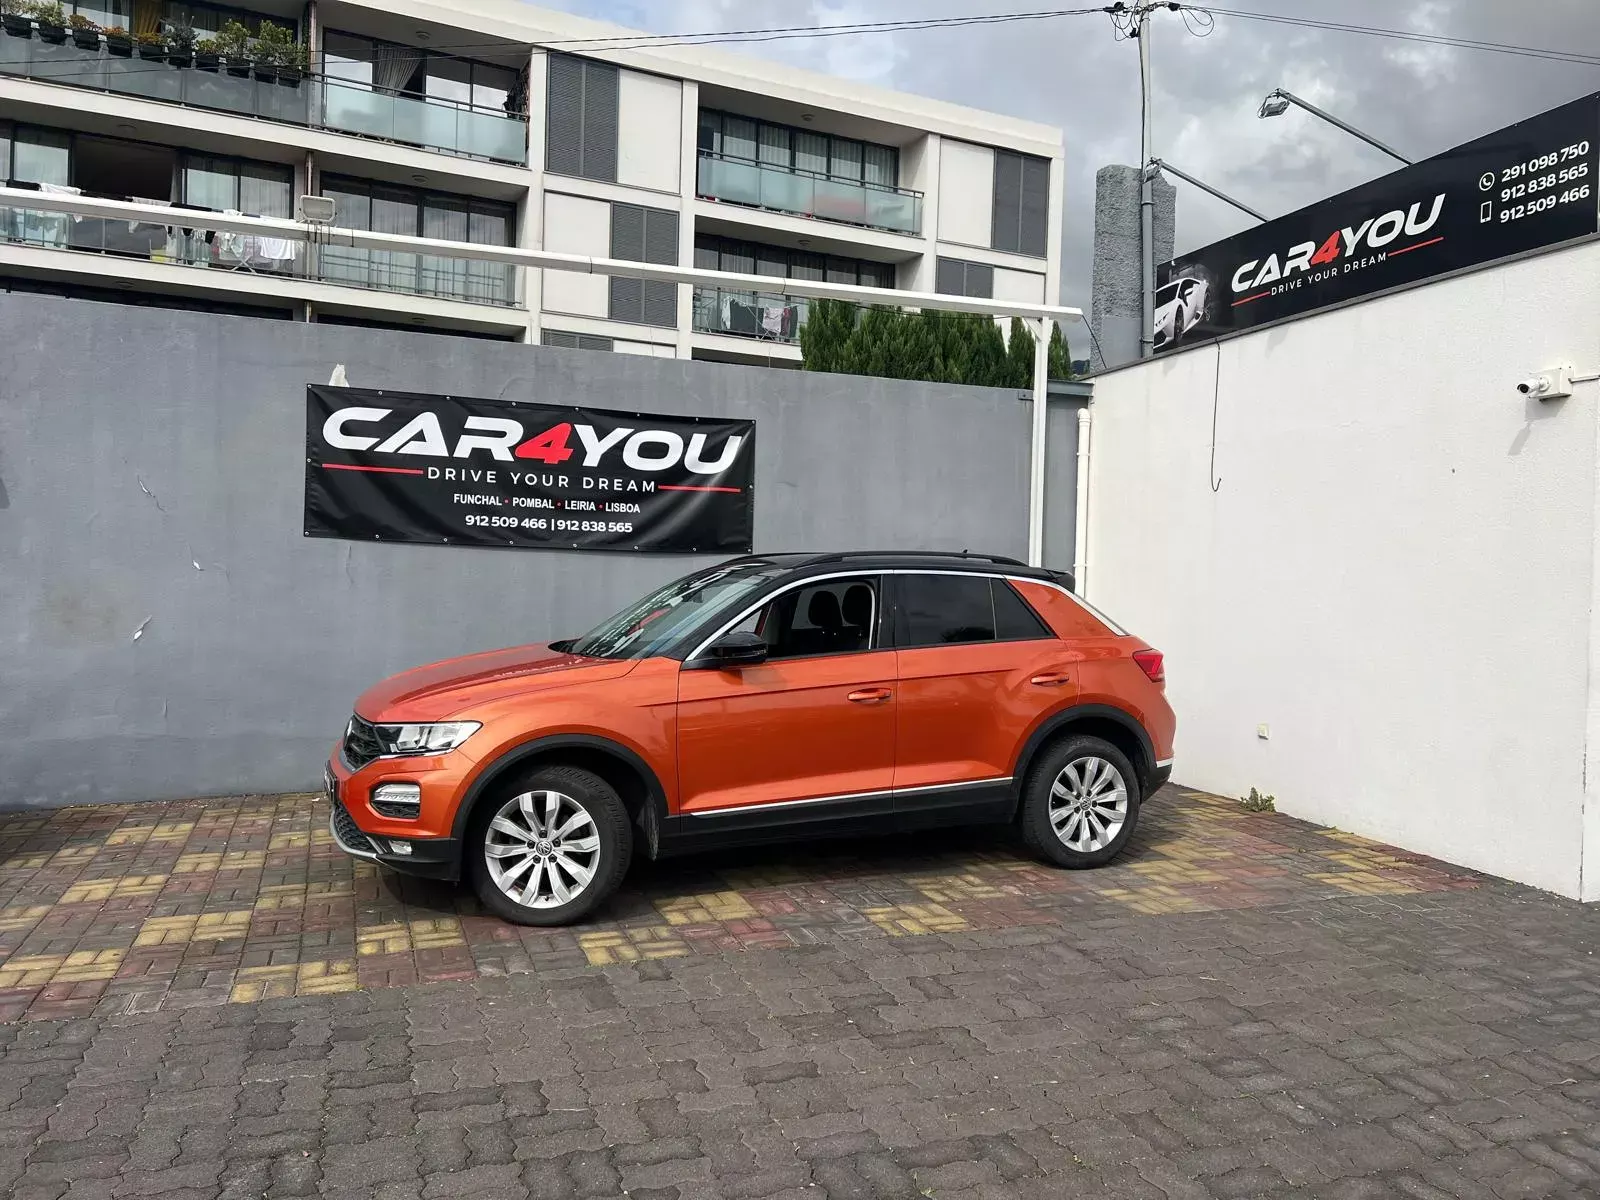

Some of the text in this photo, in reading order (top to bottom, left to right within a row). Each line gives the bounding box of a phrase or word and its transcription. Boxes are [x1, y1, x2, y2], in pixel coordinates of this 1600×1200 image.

[1501, 141, 1590, 183] 291 098 750
[1501, 162, 1589, 202] 912 838 565
[1500, 184, 1590, 224] 912 509 466
[1231, 193, 1446, 294] CAR4YOU
[1271, 252, 1387, 296] DRIVE YOUR DREAM
[322, 406, 743, 475] CAR4YOU
[427, 466, 655, 493] DRIVE YOUR DREAM
[453, 493, 641, 514] FUNCHAL POMBAL LEIRIA LISBOA
[465, 514, 490, 527] 912
[490, 516, 519, 528] 509
[520, 517, 548, 530] 466
[556, 519, 580, 531] 912
[580, 521, 607, 533] 838
[607, 522, 633, 533] 565
